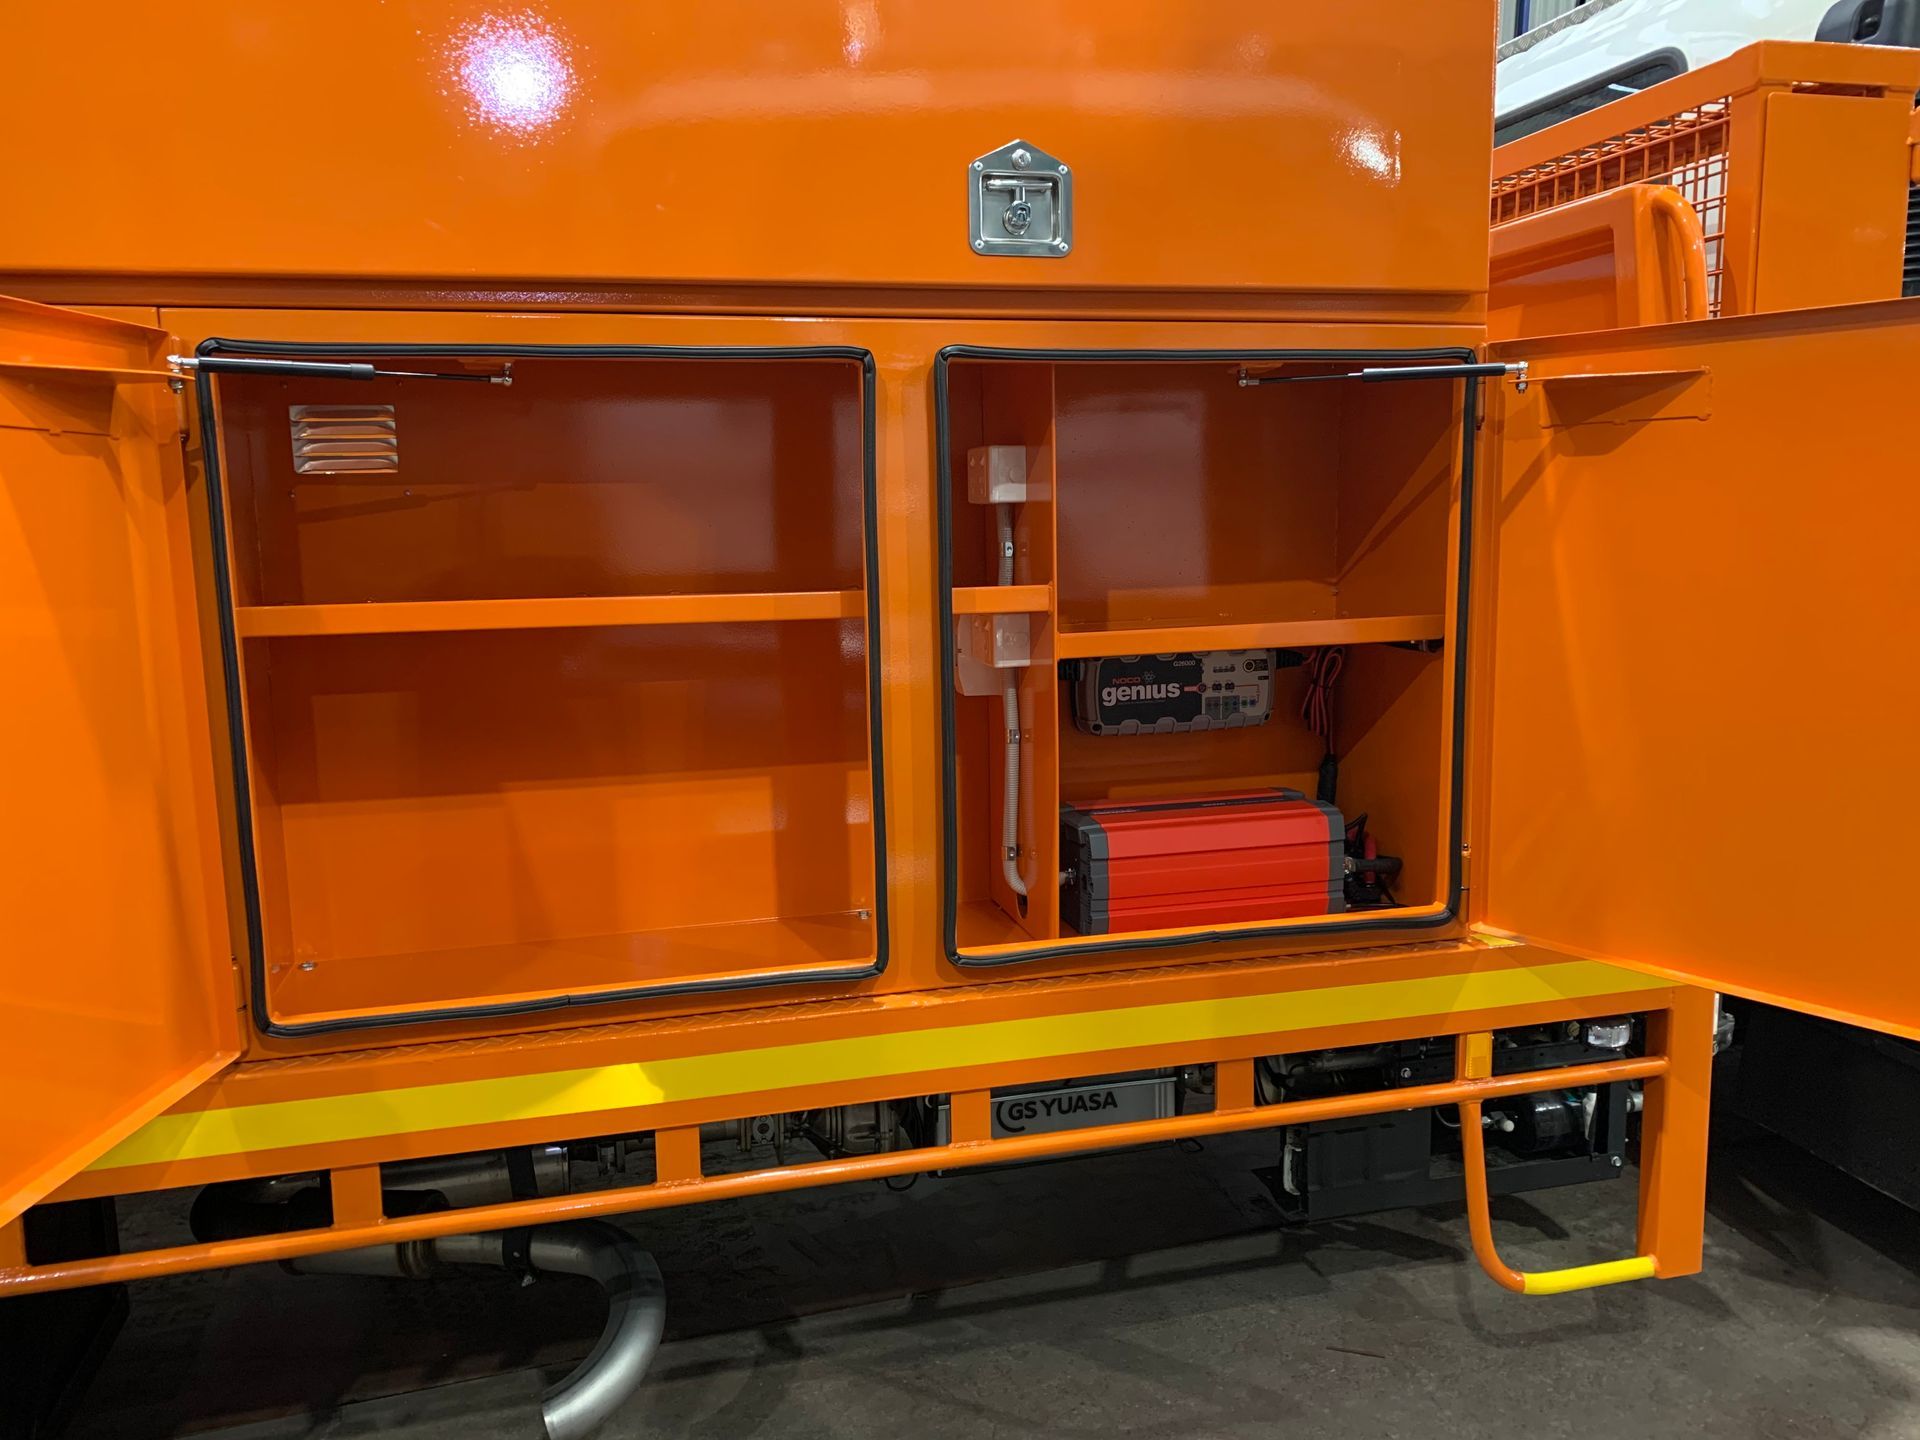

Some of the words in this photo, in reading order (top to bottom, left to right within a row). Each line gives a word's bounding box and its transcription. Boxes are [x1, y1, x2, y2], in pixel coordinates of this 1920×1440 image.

[1112, 676, 1141, 685] NOCO
[1102, 683, 1181, 706] genius
[1008, 1101, 1037, 1121] GS
[1040, 1091, 1118, 1117] YUASA
